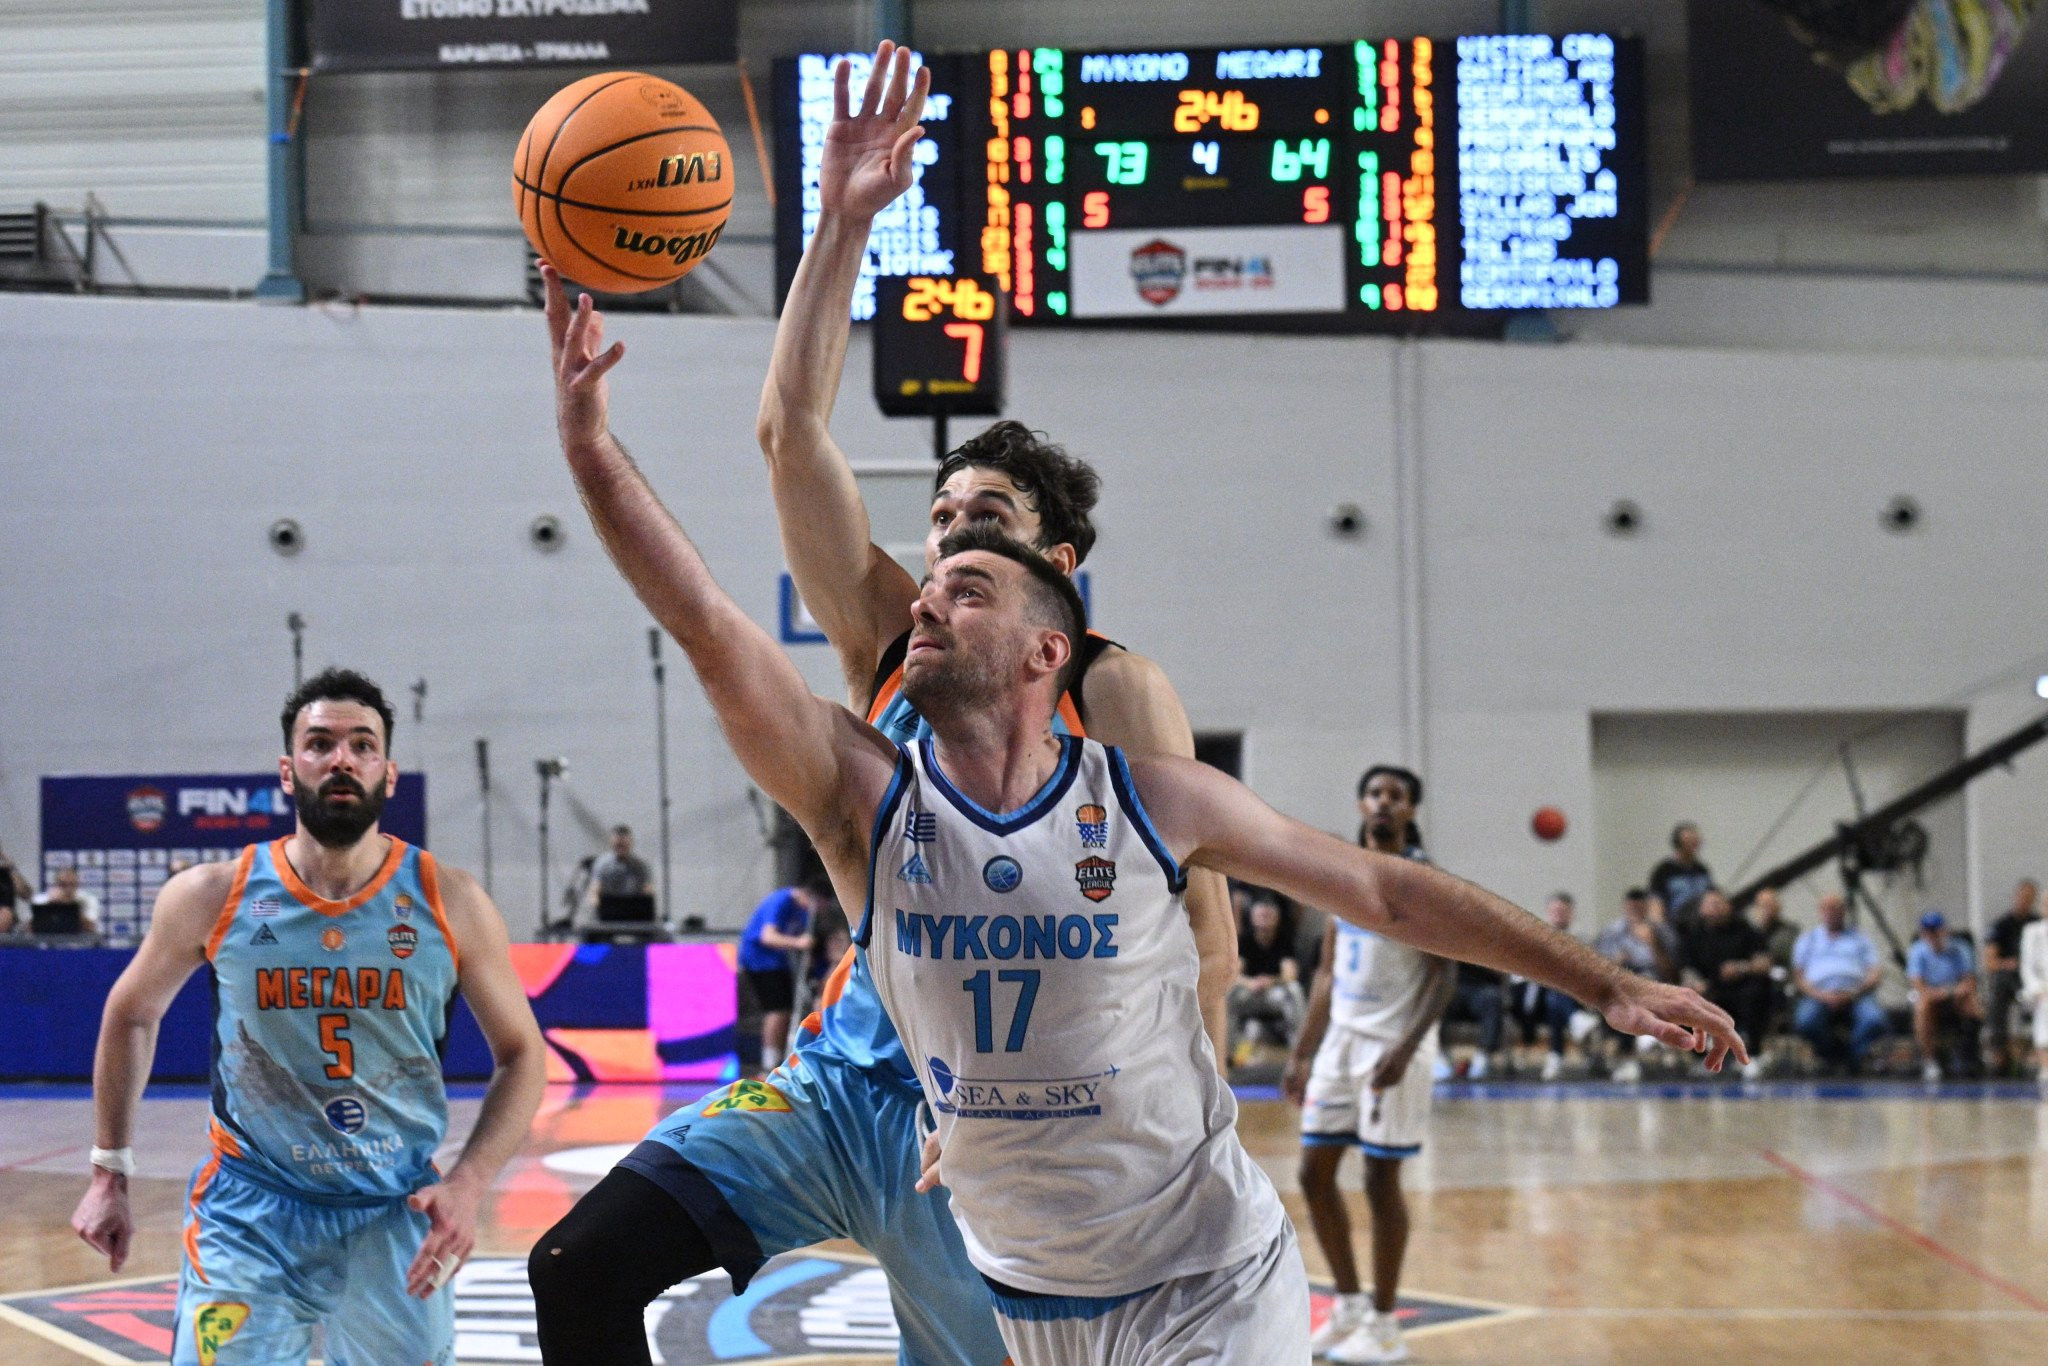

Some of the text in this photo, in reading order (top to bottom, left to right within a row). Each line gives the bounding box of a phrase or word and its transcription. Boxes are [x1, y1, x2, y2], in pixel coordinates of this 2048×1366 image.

[656, 151, 721, 188] EVO
[1094, 141, 1148, 185] 73
[1192, 141, 1220, 175] 4
[1271, 138, 1330, 182] 64
[1083, 192, 1110, 228] 5
[1303, 186, 1330, 223] 5
[614, 219, 727, 265] Wilson
[943, 323, 983, 383] 7
[1078, 866, 1114, 879] ELITE
[256, 967, 407, 1010] ΜΕΓΑΡΑ
[962, 969, 1041, 1054] 17
[318, 1013, 355, 1080] 5
[955, 1082, 1099, 1106] SEA & SKY
